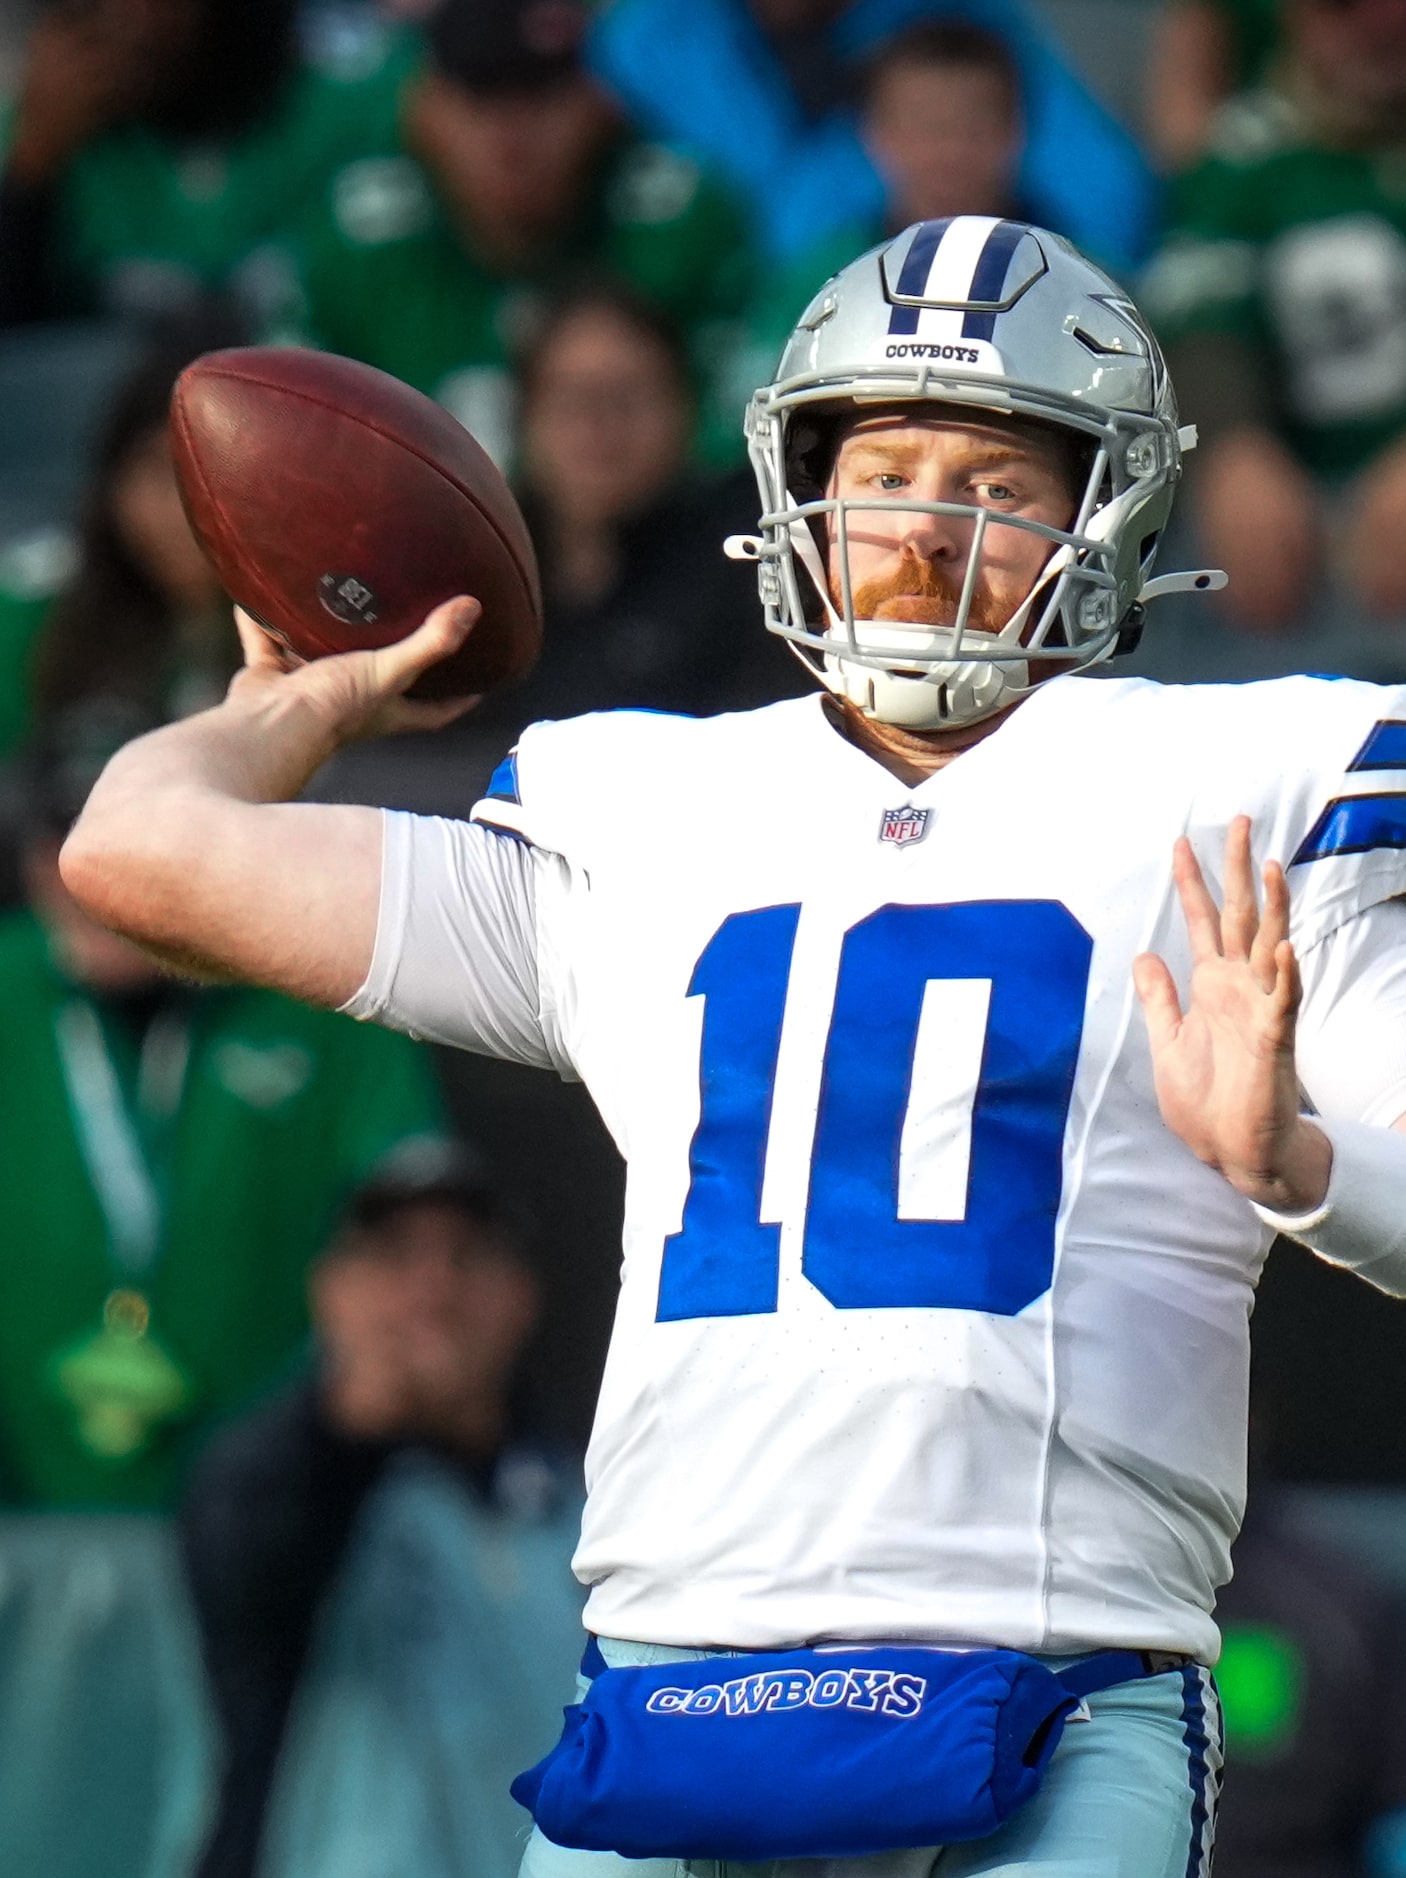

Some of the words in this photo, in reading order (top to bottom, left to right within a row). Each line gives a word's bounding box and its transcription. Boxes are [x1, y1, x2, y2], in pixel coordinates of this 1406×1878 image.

[886, 344, 980, 363] COWBOYS
[884, 821, 920, 840] NFL
[655, 898, 1094, 1323] 10
[646, 1668, 927, 1718] COWBOYS
